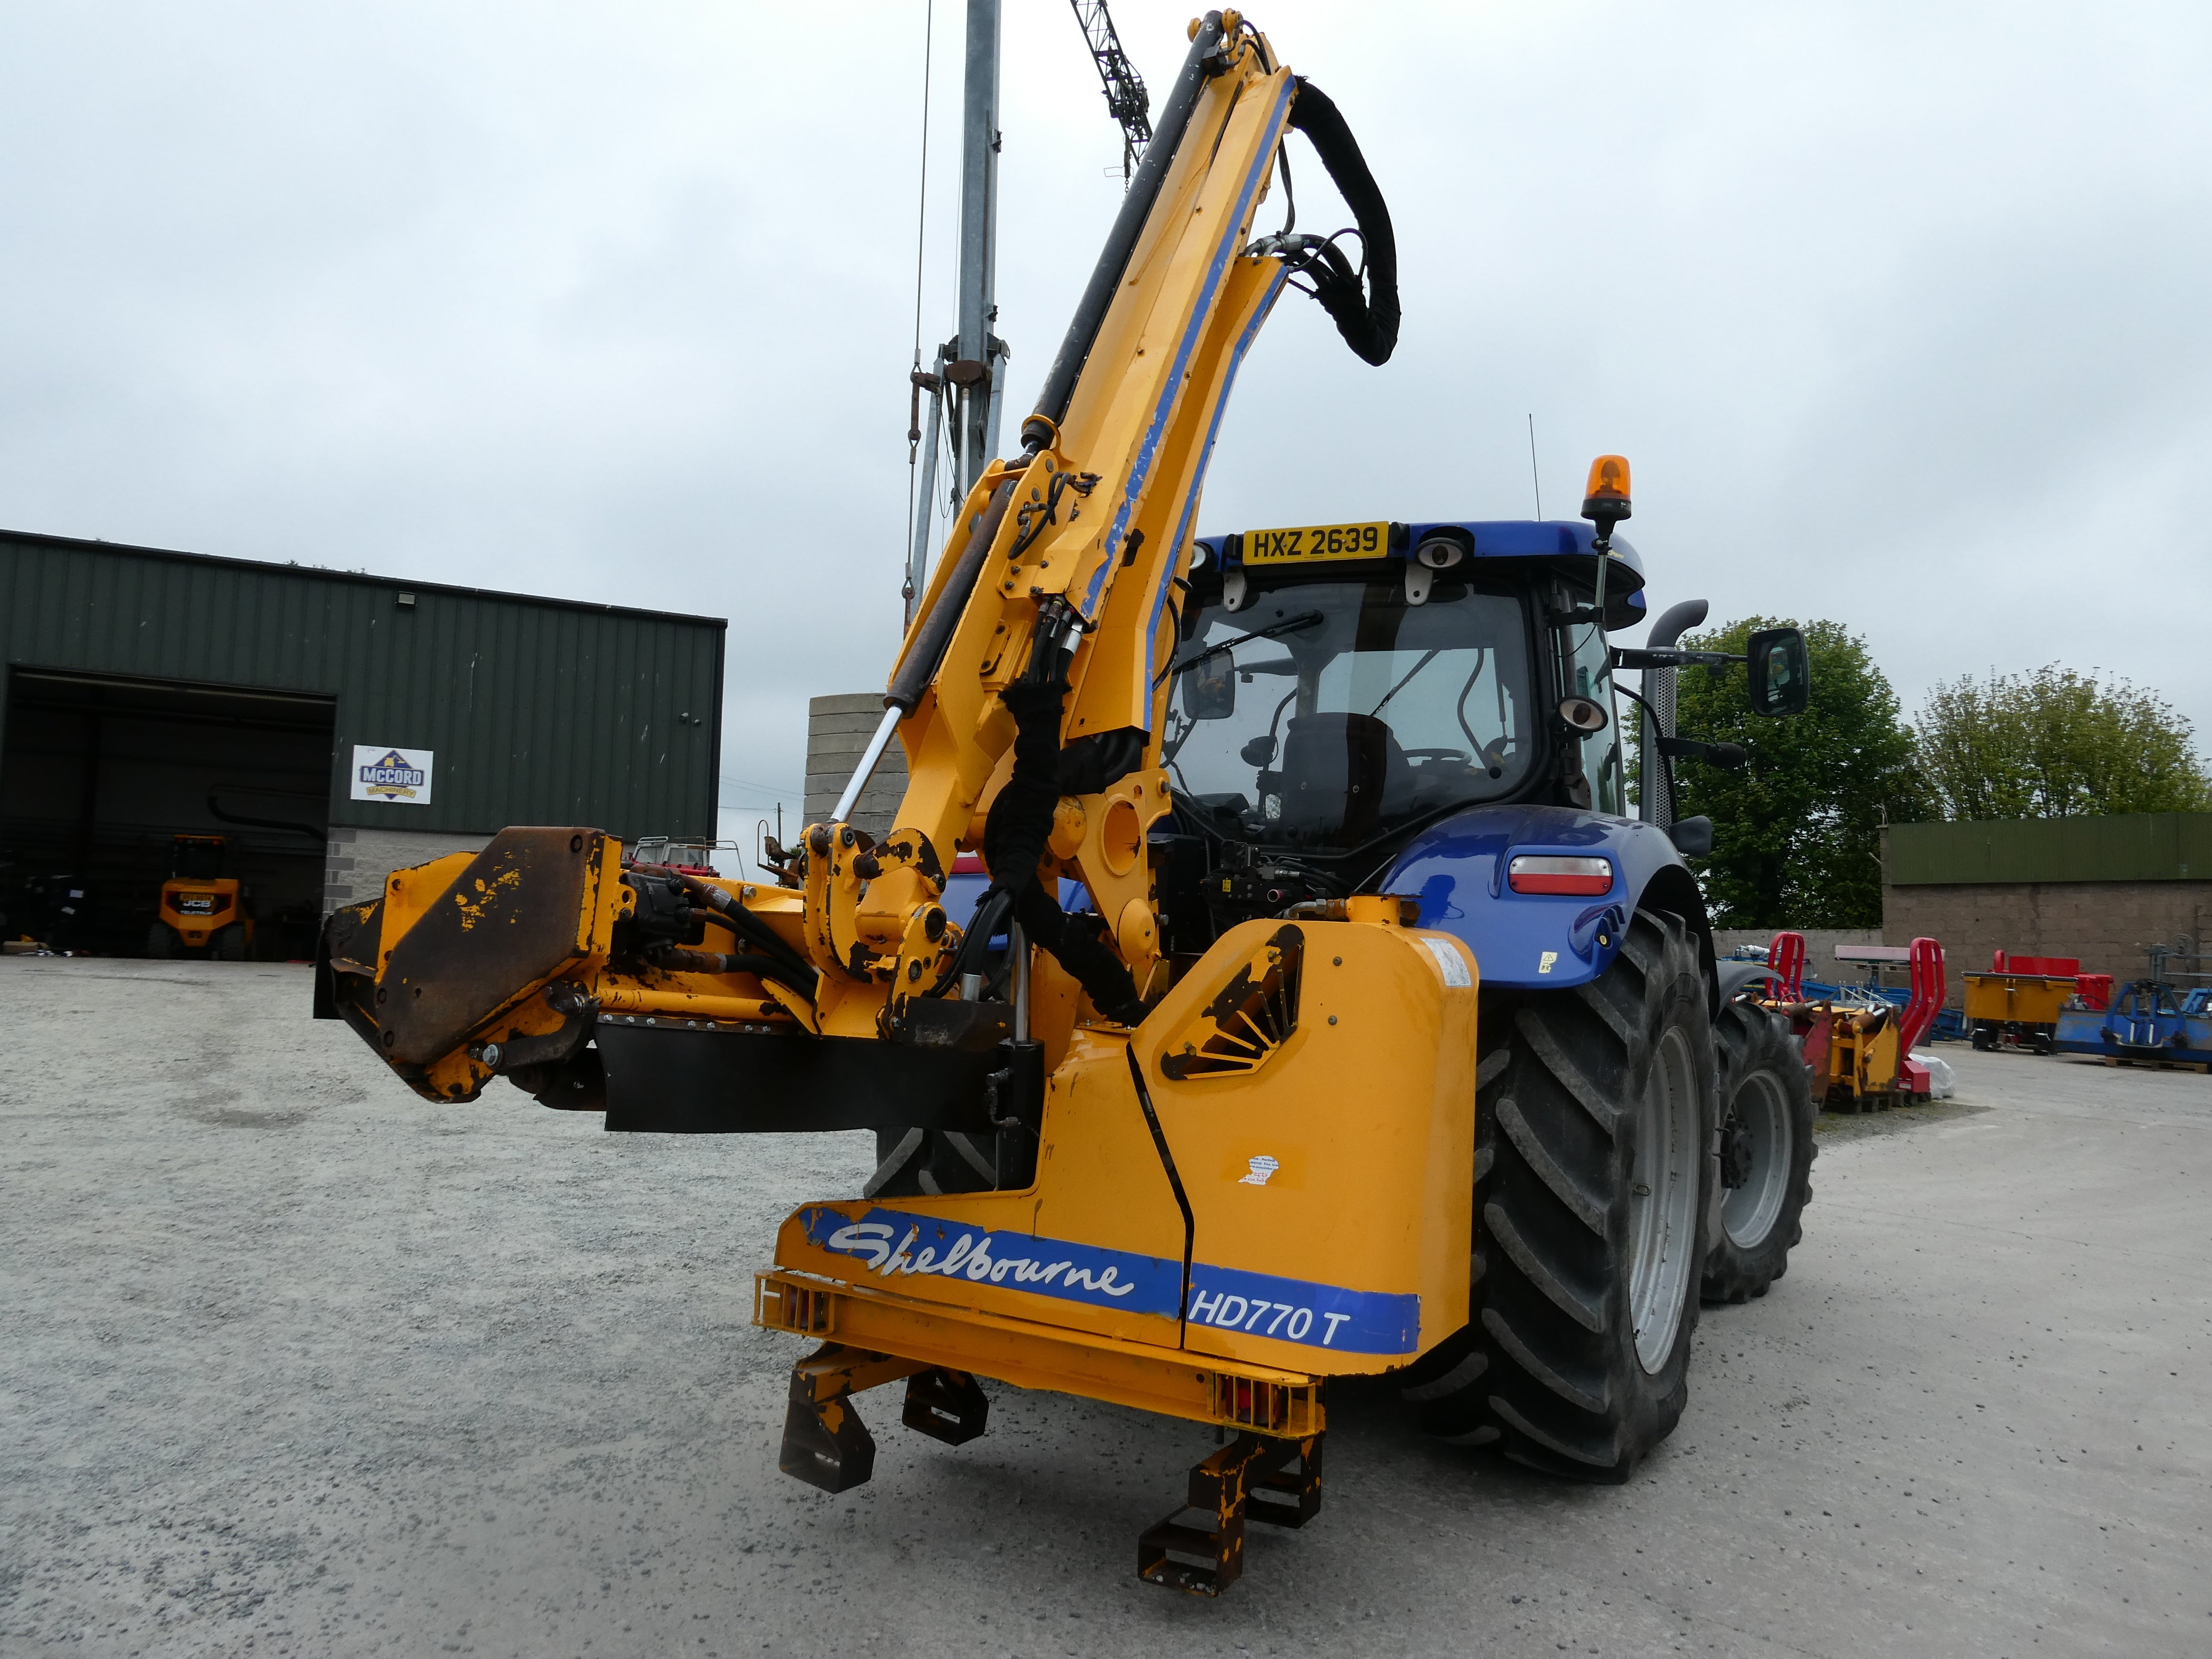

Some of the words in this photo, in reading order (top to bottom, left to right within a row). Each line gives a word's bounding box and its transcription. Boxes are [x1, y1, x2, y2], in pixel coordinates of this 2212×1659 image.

[1254, 531, 1302, 557] HXZ
[1310, 527, 1378, 554] 2639
[368, 786, 414, 796] MACHINERY
[829, 1222, 1134, 1296] Shelbourne
[1188, 1290, 1313, 1339] HD770
[1323, 1312, 1350, 1345] T
